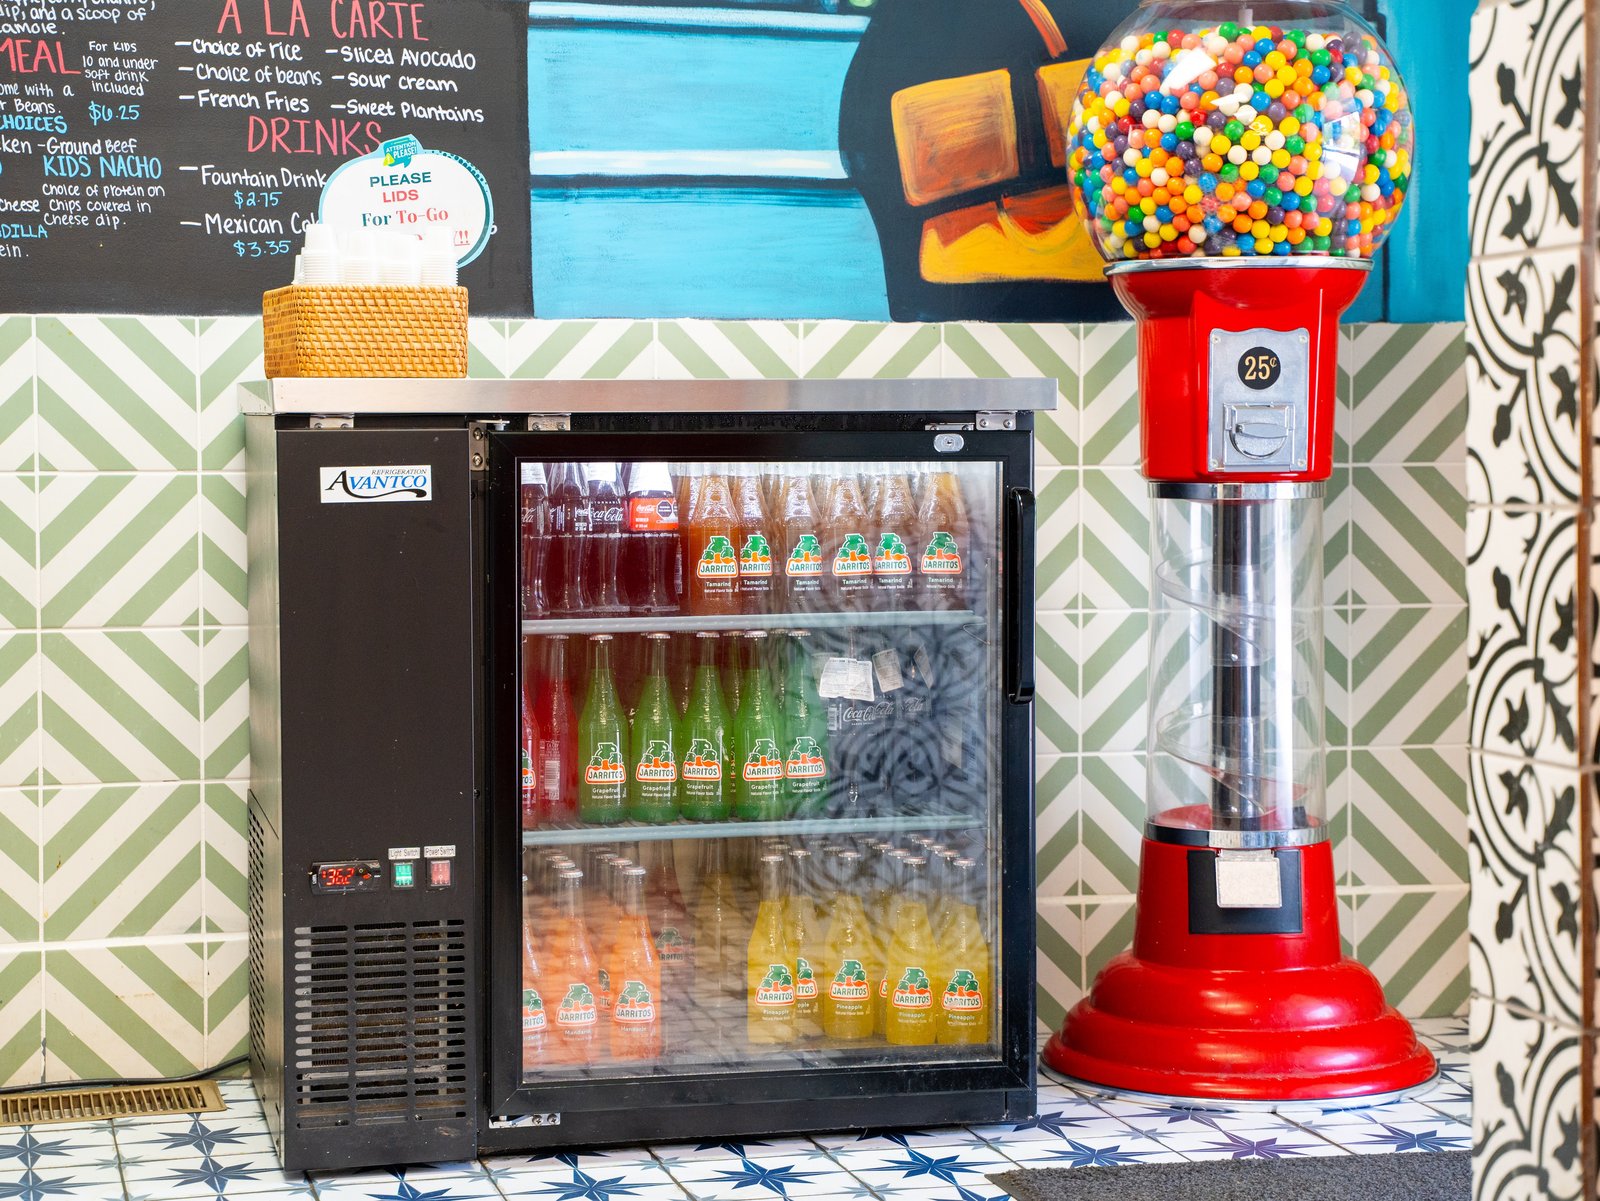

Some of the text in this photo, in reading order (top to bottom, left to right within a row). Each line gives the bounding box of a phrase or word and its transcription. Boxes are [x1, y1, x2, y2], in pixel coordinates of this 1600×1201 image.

[30, 7, 57, 21] and
[61, 8, 73, 20] a
[77, 7, 120, 23] scoop
[127, 7, 146, 20] of
[217, 0, 430, 41] A LA CARTE
[88, 41, 108, 52] For
[245, 41, 266, 58] of
[269, 42, 303, 61] rice
[82, 55, 159, 70] 10 and under
[400, 48, 476, 70] Avocado
[84, 69, 110, 81] soft
[255, 65, 272, 83] of
[275, 66, 322, 86] beans
[24, 82, 54, 97] with
[62, 85, 75, 97] a
[91, 80, 145, 96] included
[13, 98, 62, 114] Beans.
[197, 89, 310, 114] French Fries
[88, 101, 141, 126] $6.25
[347, 99, 485, 123] Sweet Plantains
[247, 116, 382, 156] DRINKS
[104, 138, 138, 154] Beef
[43, 155, 162, 179] KIDS NACHO
[201, 165, 279, 188] Fountain
[369, 172, 432, 187] PLEASE
[85, 184, 99, 197] of
[103, 184, 145, 198] protein
[147, 185, 166, 197] on
[383, 189, 419, 203] LIDS
[86, 200, 132, 213] covered
[137, 200, 152, 213] in
[233, 190, 283, 209] $2.75
[95, 213, 126, 230] dip.
[204, 211, 284, 235] Mexican
[361, 207, 449, 227] For To-Go
[233, 240, 292, 257] $3.35
[1245, 354, 1278, 380] 25¢
[325, 469, 428, 498] AVANTCO
[700, 564, 735, 573] JARRITOS
[790, 562, 822, 571] JARRITOS
[837, 560, 870, 571] JARRITOS
[875, 560, 907, 569] JARRITOS
[923, 560, 958, 569] JARRITOS
[588, 770, 623, 780] JARRITOS
[640, 769, 674, 777] JARRITOS
[684, 767, 718, 776] JARRITOS
[747, 766, 780, 776] JARRITOS
[789, 764, 822, 773] JARRITOS
[758, 992, 793, 1001] JARRITOS
[832, 987, 867, 996] JARRITOS
[895, 994, 930, 1004] JARRITOS
[944, 996, 980, 1006] JARRITOS
[559, 1011, 595, 1021] JARRITOS
[616, 1008, 651, 1017] JARRITOS
